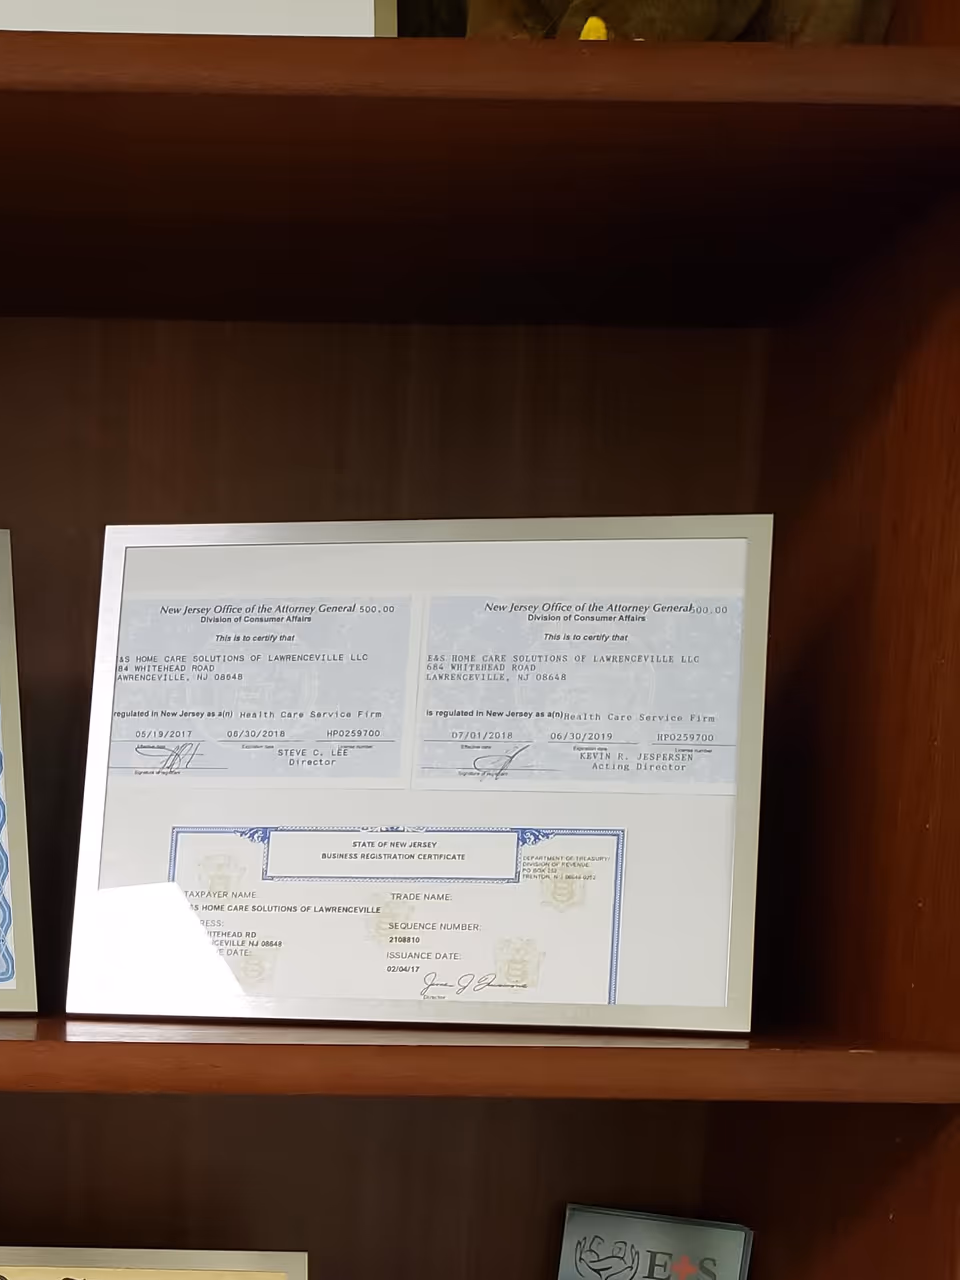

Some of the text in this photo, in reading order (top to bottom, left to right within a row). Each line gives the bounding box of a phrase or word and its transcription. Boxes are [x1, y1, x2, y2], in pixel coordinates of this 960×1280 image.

[159, 602, 395, 616] New Jersey Office of the Attorney General 500.00
[135, 653, 368, 664] HOME CARE SOLUTIONS OF LAWRENCEVILLE LLC
[134, 729, 381, 739] 05/19/2017 06/30/2018 HP0259700
[451, 731, 715, 743] 07/01/2018 06/30/2019 HP0259700
[277, 748, 348, 757] STEVE C. LEE
[579, 751, 693, 762] KEVIN R. JESPERSEN
[288, 758, 336, 767] Director
[360, 852, 415, 860] REGISTRATION
[388, 921, 481, 931] SEQUENCE NUMBER:
